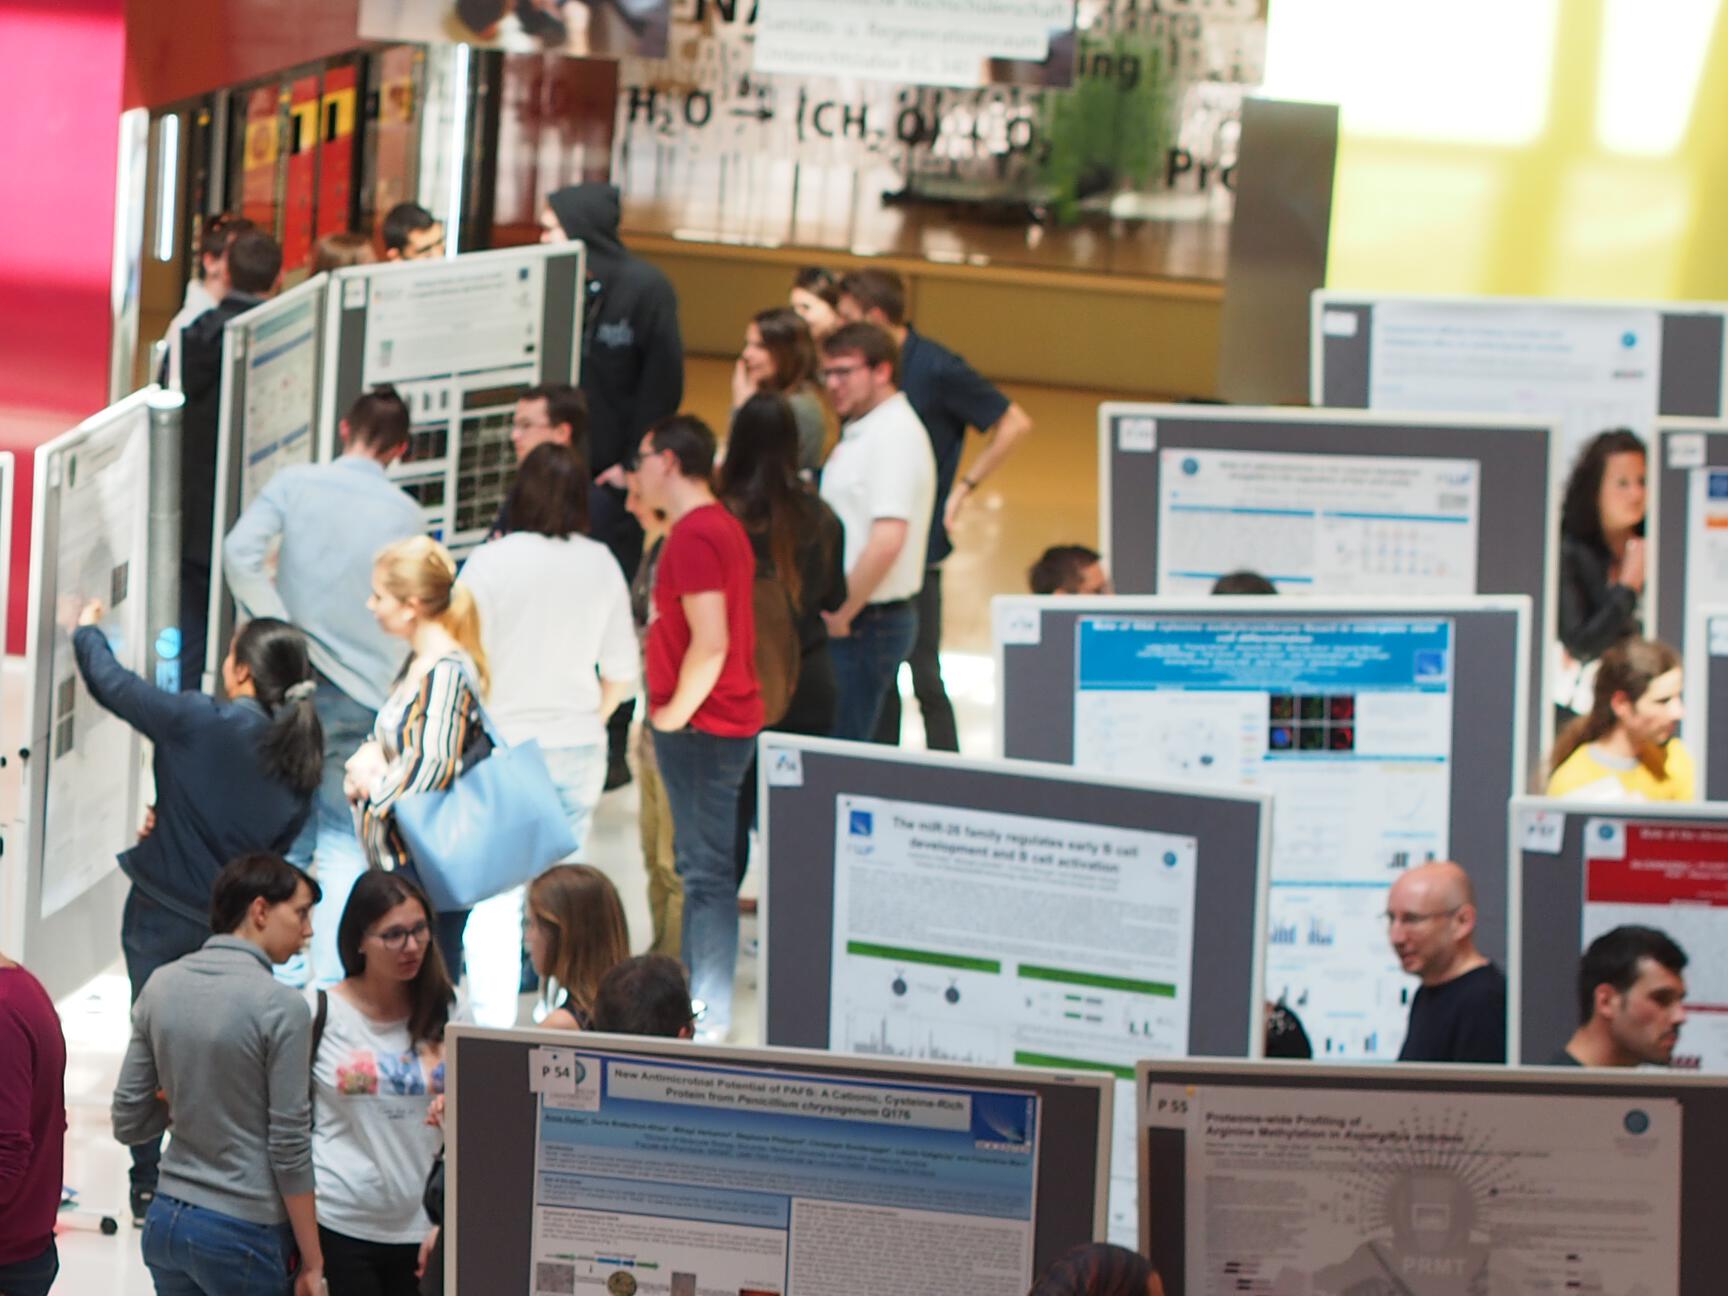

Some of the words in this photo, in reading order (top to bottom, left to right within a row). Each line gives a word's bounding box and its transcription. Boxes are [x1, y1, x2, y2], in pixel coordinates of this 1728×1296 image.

[892, 815, 915, 829] The
[964, 825, 1002, 843] family
[1006, 834, 1064, 848] regulates
[1068, 841, 1098, 854] early
[1116, 846, 1138, 857] cell
[910, 837, 988, 856] development
[992, 850, 1015, 860] and
[1032, 855, 1053, 864] cell
[1058, 858, 1119, 872] activation
[542, 1065, 550, 1077] P
[554, 1066, 570, 1079] 54
[614, 1068, 638, 1080] New
[641, 1071, 714, 1087] Antimicrobial
[717, 1079, 766, 1095] Potential
[769, 1084, 781, 1094] of
[884, 1094, 964, 1112] Cysteine-Rich
[666, 1088, 705, 1102] Protein
[708, 1092, 734, 1104] from
[738, 1095, 799, 1110] Penicillium
[802, 1102, 879, 1119] chrysogenum
[1157, 1098, 1167, 1111] P
[1170, 1099, 1188, 1114] 55
[1205, 1112, 1292, 1125] Proteome-wide
[1296, 1114, 1346, 1128] Profiling
[1350, 1116, 1362, 1126] of
[1205, 1125, 1255, 1139] Arginine
[1258, 1127, 1326, 1140] Methylation
[1329, 1131, 1340, 1139] in
[1402, 1255, 1467, 1275] PRMT
